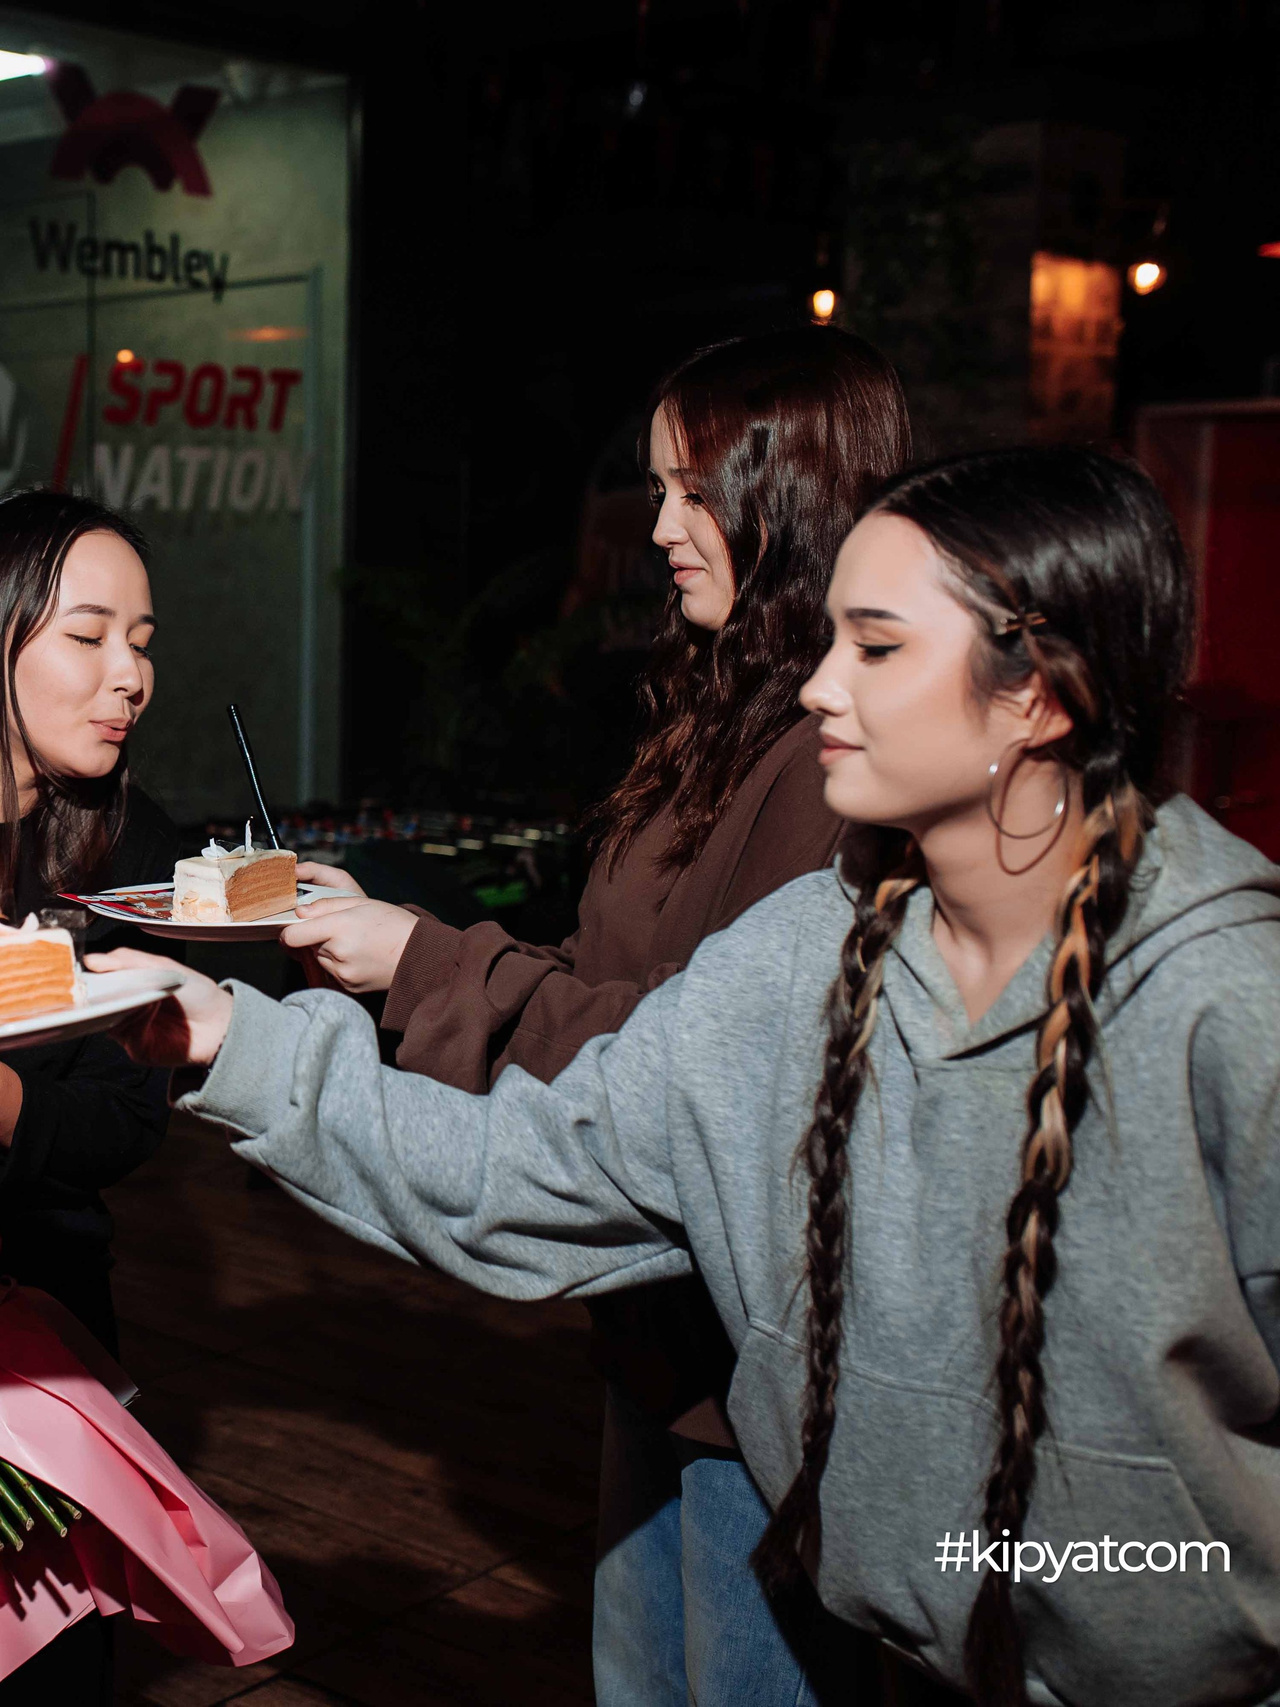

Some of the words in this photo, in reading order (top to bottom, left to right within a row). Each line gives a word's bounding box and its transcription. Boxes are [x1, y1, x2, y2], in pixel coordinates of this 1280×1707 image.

[28, 216, 228, 302] Wembley
[102, 356, 303, 433] SPORT
[78, 441, 312, 511] NATION
